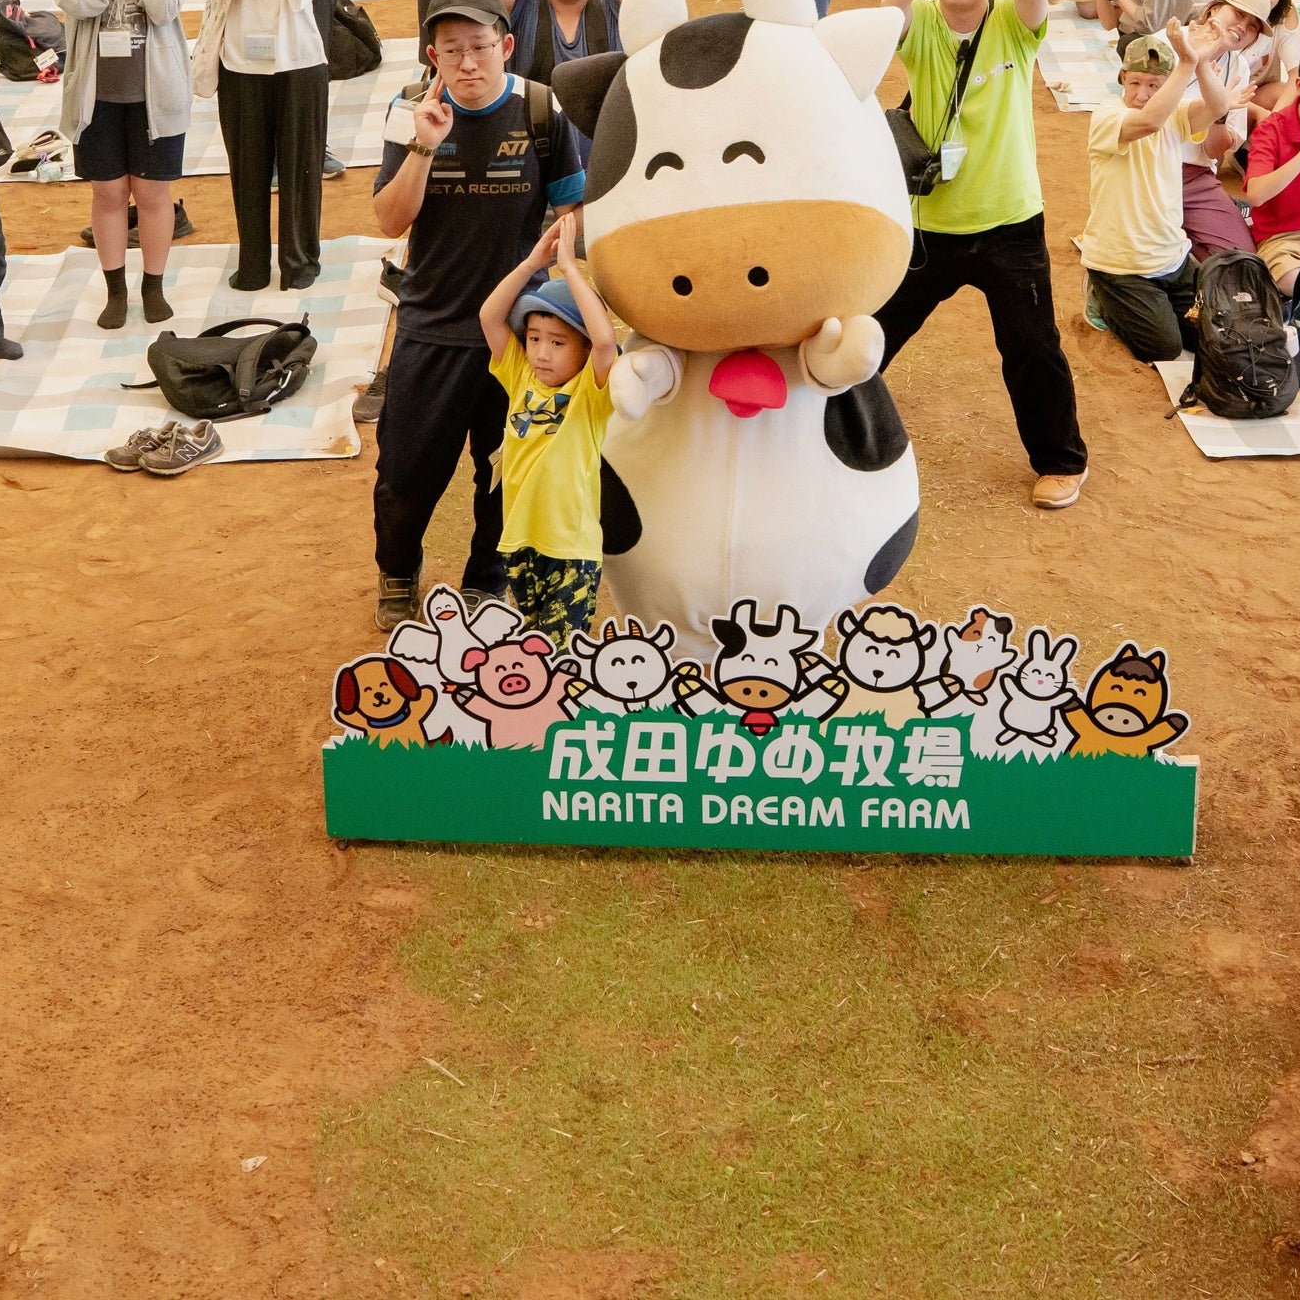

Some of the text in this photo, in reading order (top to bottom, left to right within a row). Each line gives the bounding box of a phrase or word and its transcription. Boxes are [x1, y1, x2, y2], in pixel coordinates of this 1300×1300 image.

[497, 140, 529, 156] A77
[454, 184, 465, 194] A
[469, 182, 531, 194] RECORD
[548, 720, 965, 788] 成田ゆめ牧場
[542, 790, 970, 830] NARITA DREAM FARM
